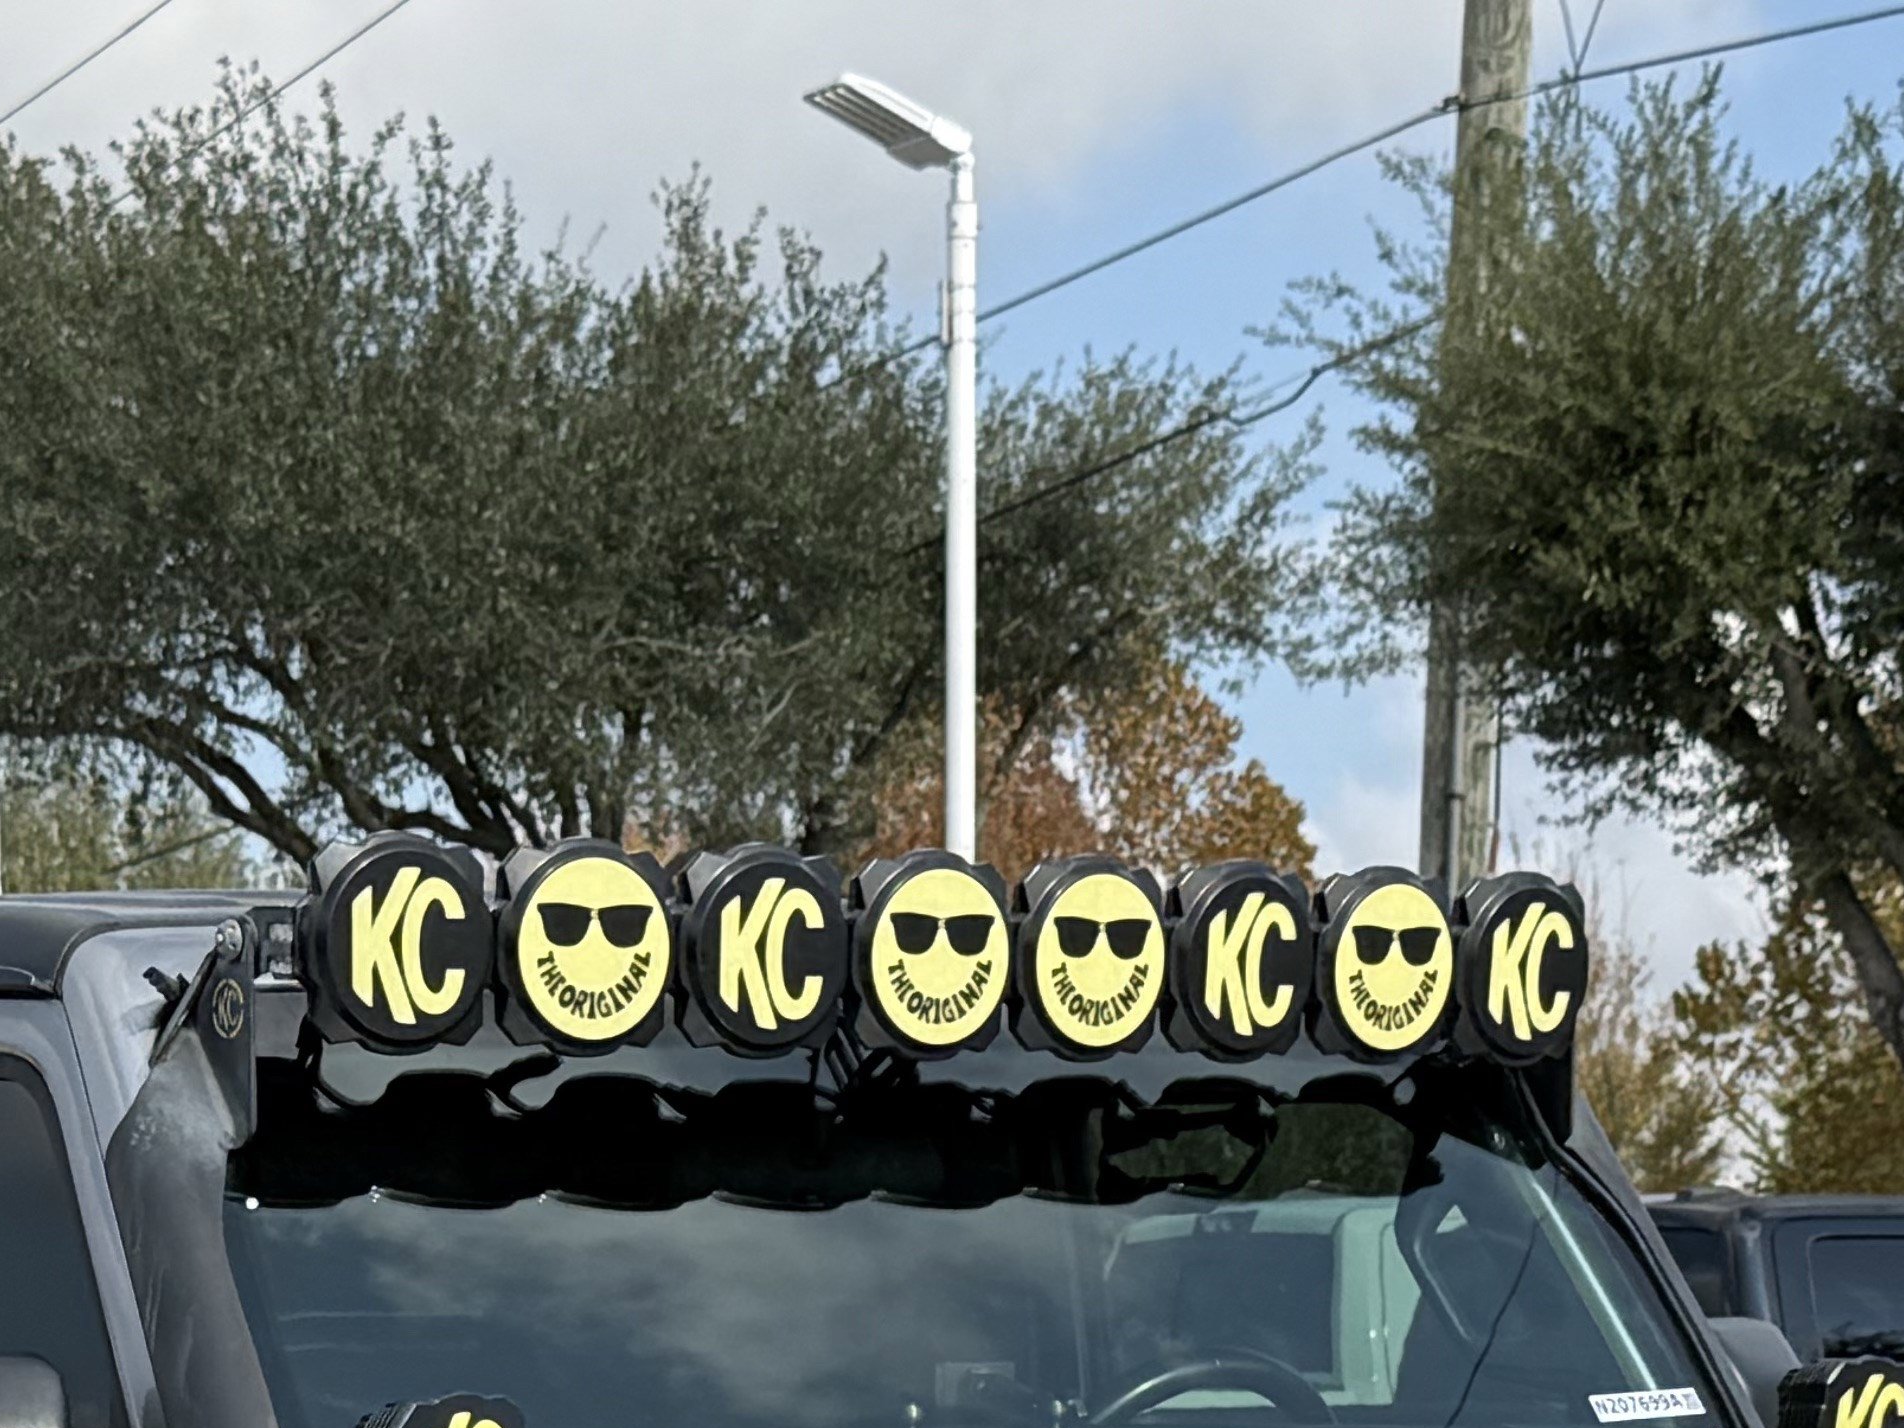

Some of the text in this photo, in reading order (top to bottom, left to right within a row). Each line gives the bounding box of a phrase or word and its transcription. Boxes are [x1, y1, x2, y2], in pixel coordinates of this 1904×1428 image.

[351, 867, 465, 1024] KC
[719, 877, 824, 1030] KC
[1205, 891, 1296, 1036] KC
[1489, 902, 1573, 1040] KC
